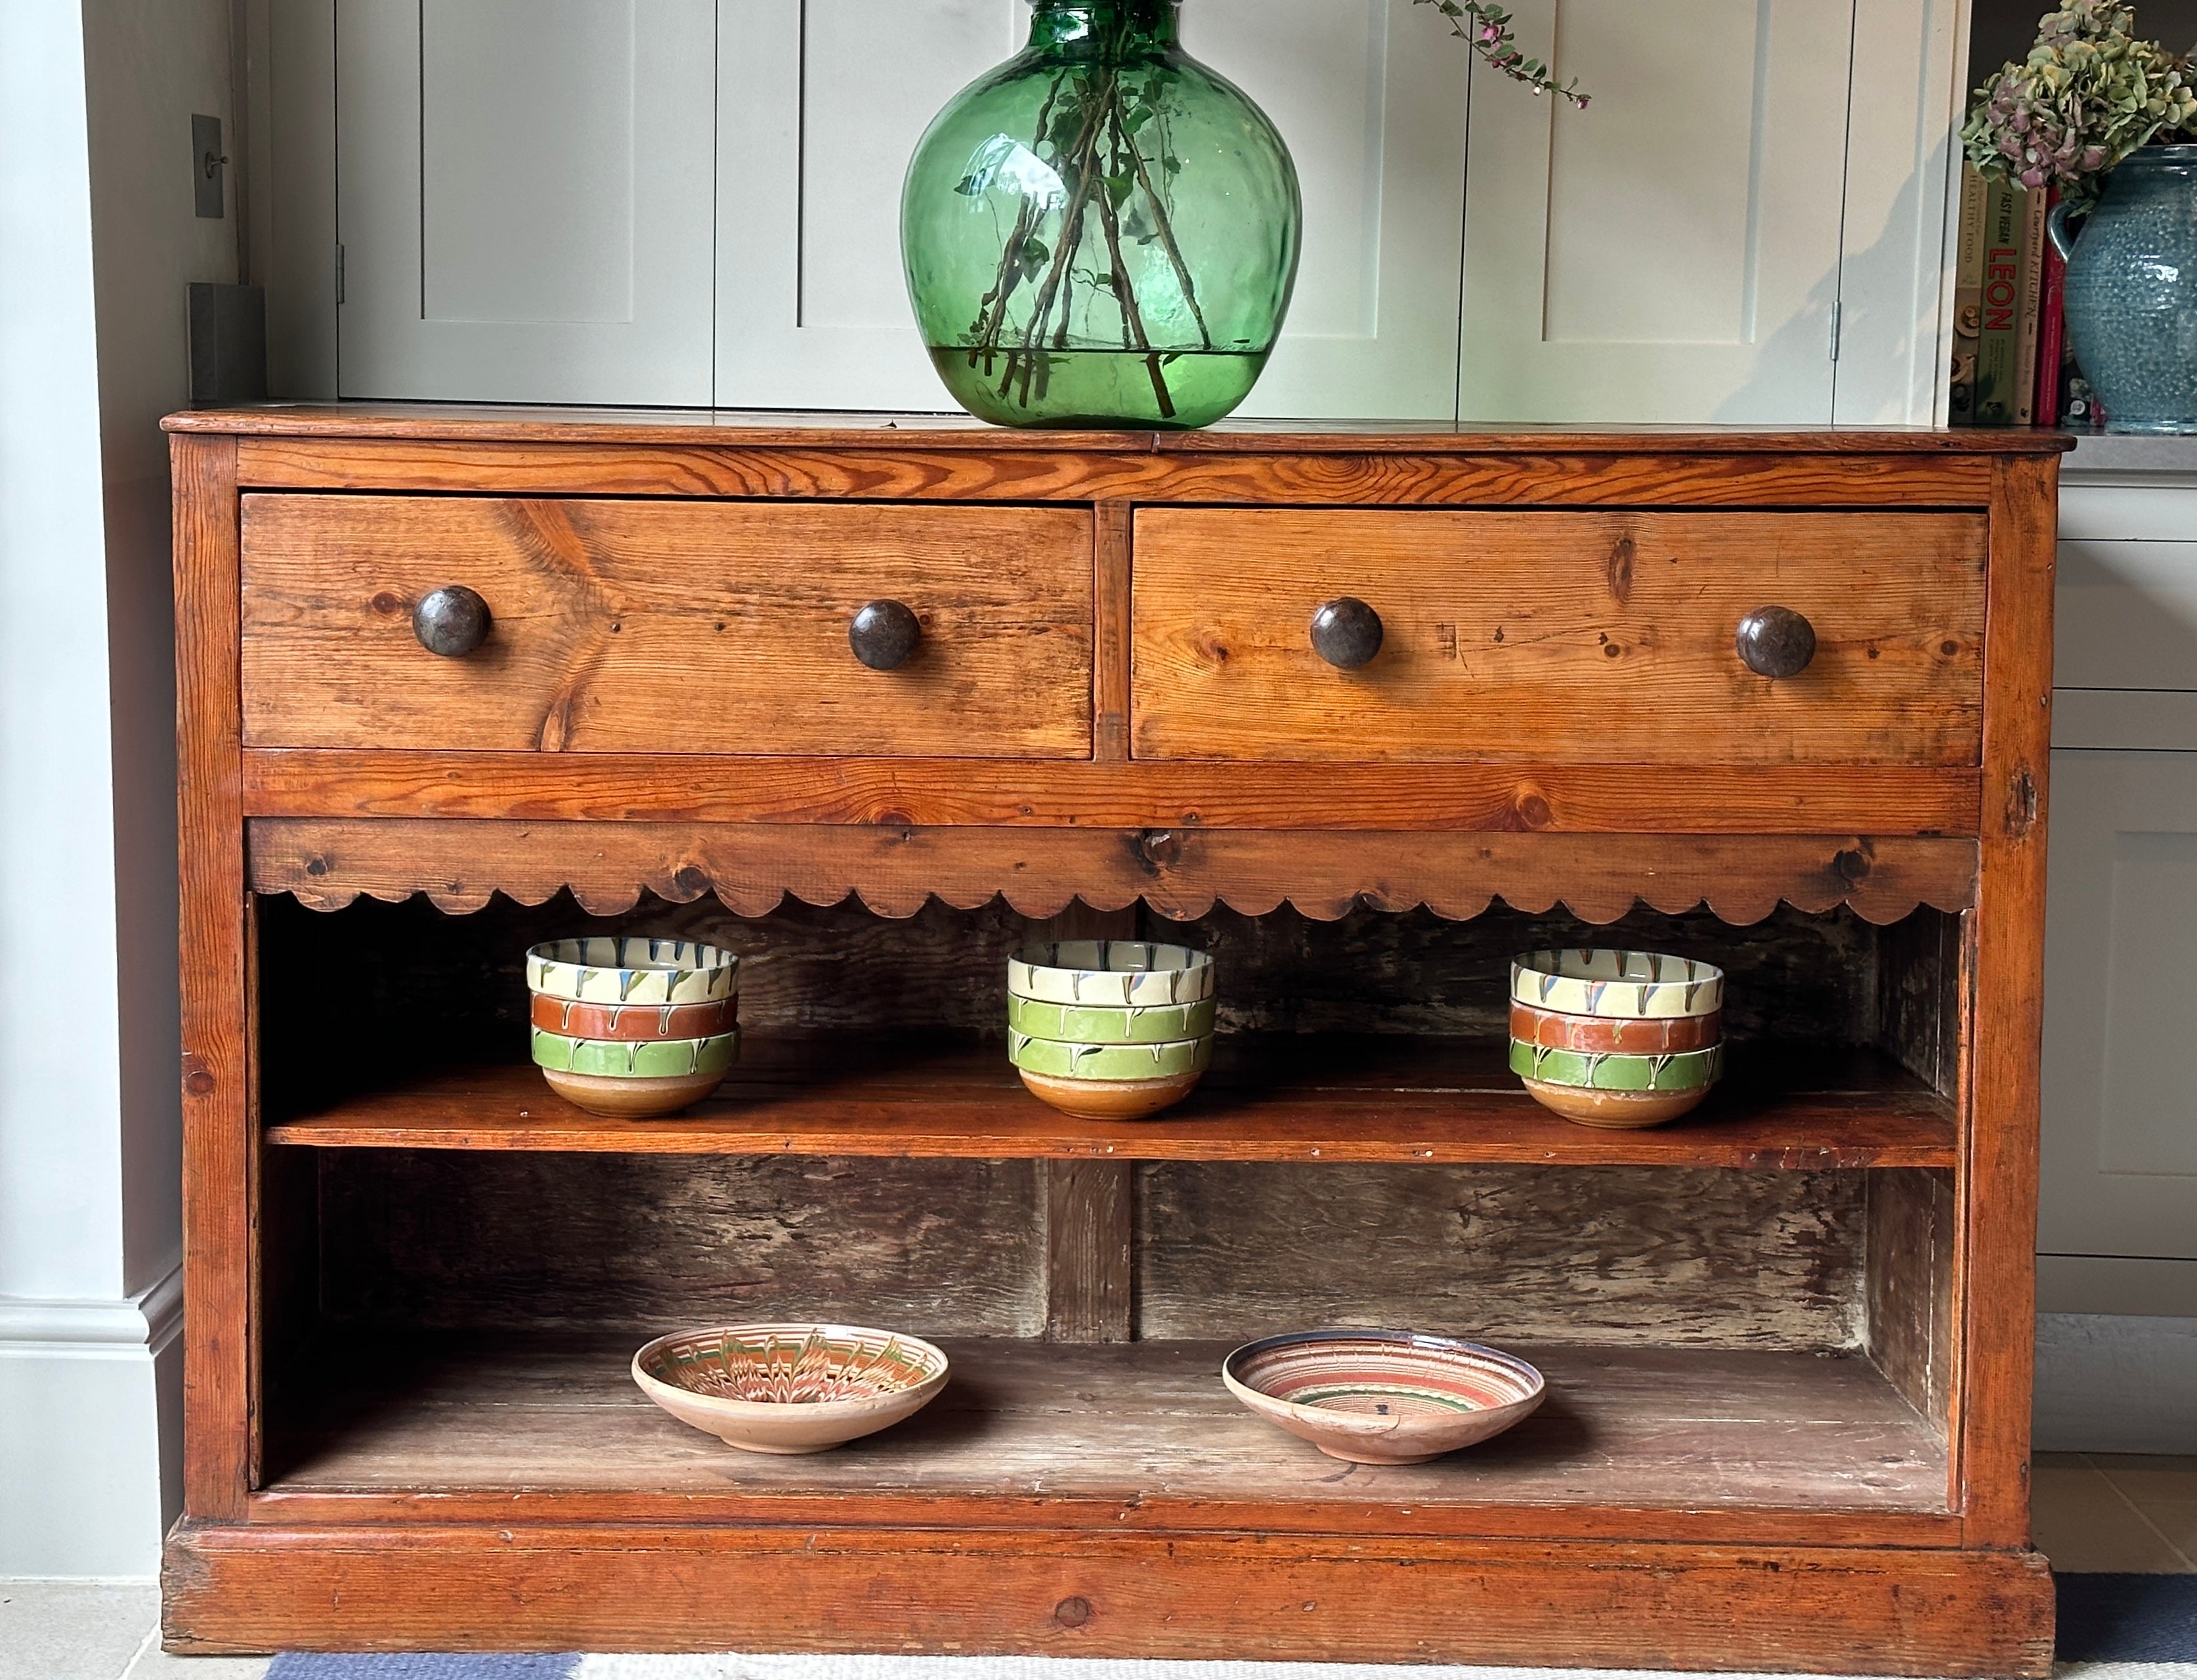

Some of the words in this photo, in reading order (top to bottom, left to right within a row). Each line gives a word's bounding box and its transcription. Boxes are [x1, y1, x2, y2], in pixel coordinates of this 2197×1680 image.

[1967, 175, 1977, 227] HEALTHY
[2000, 192, 2013, 215] FAST
[1998, 216, 2011, 245] VEGAN
[2030, 209, 2042, 258] Courtyard
[1986, 249, 2016, 330] LEON
[2025, 261, 2039, 318] KITCHEN
